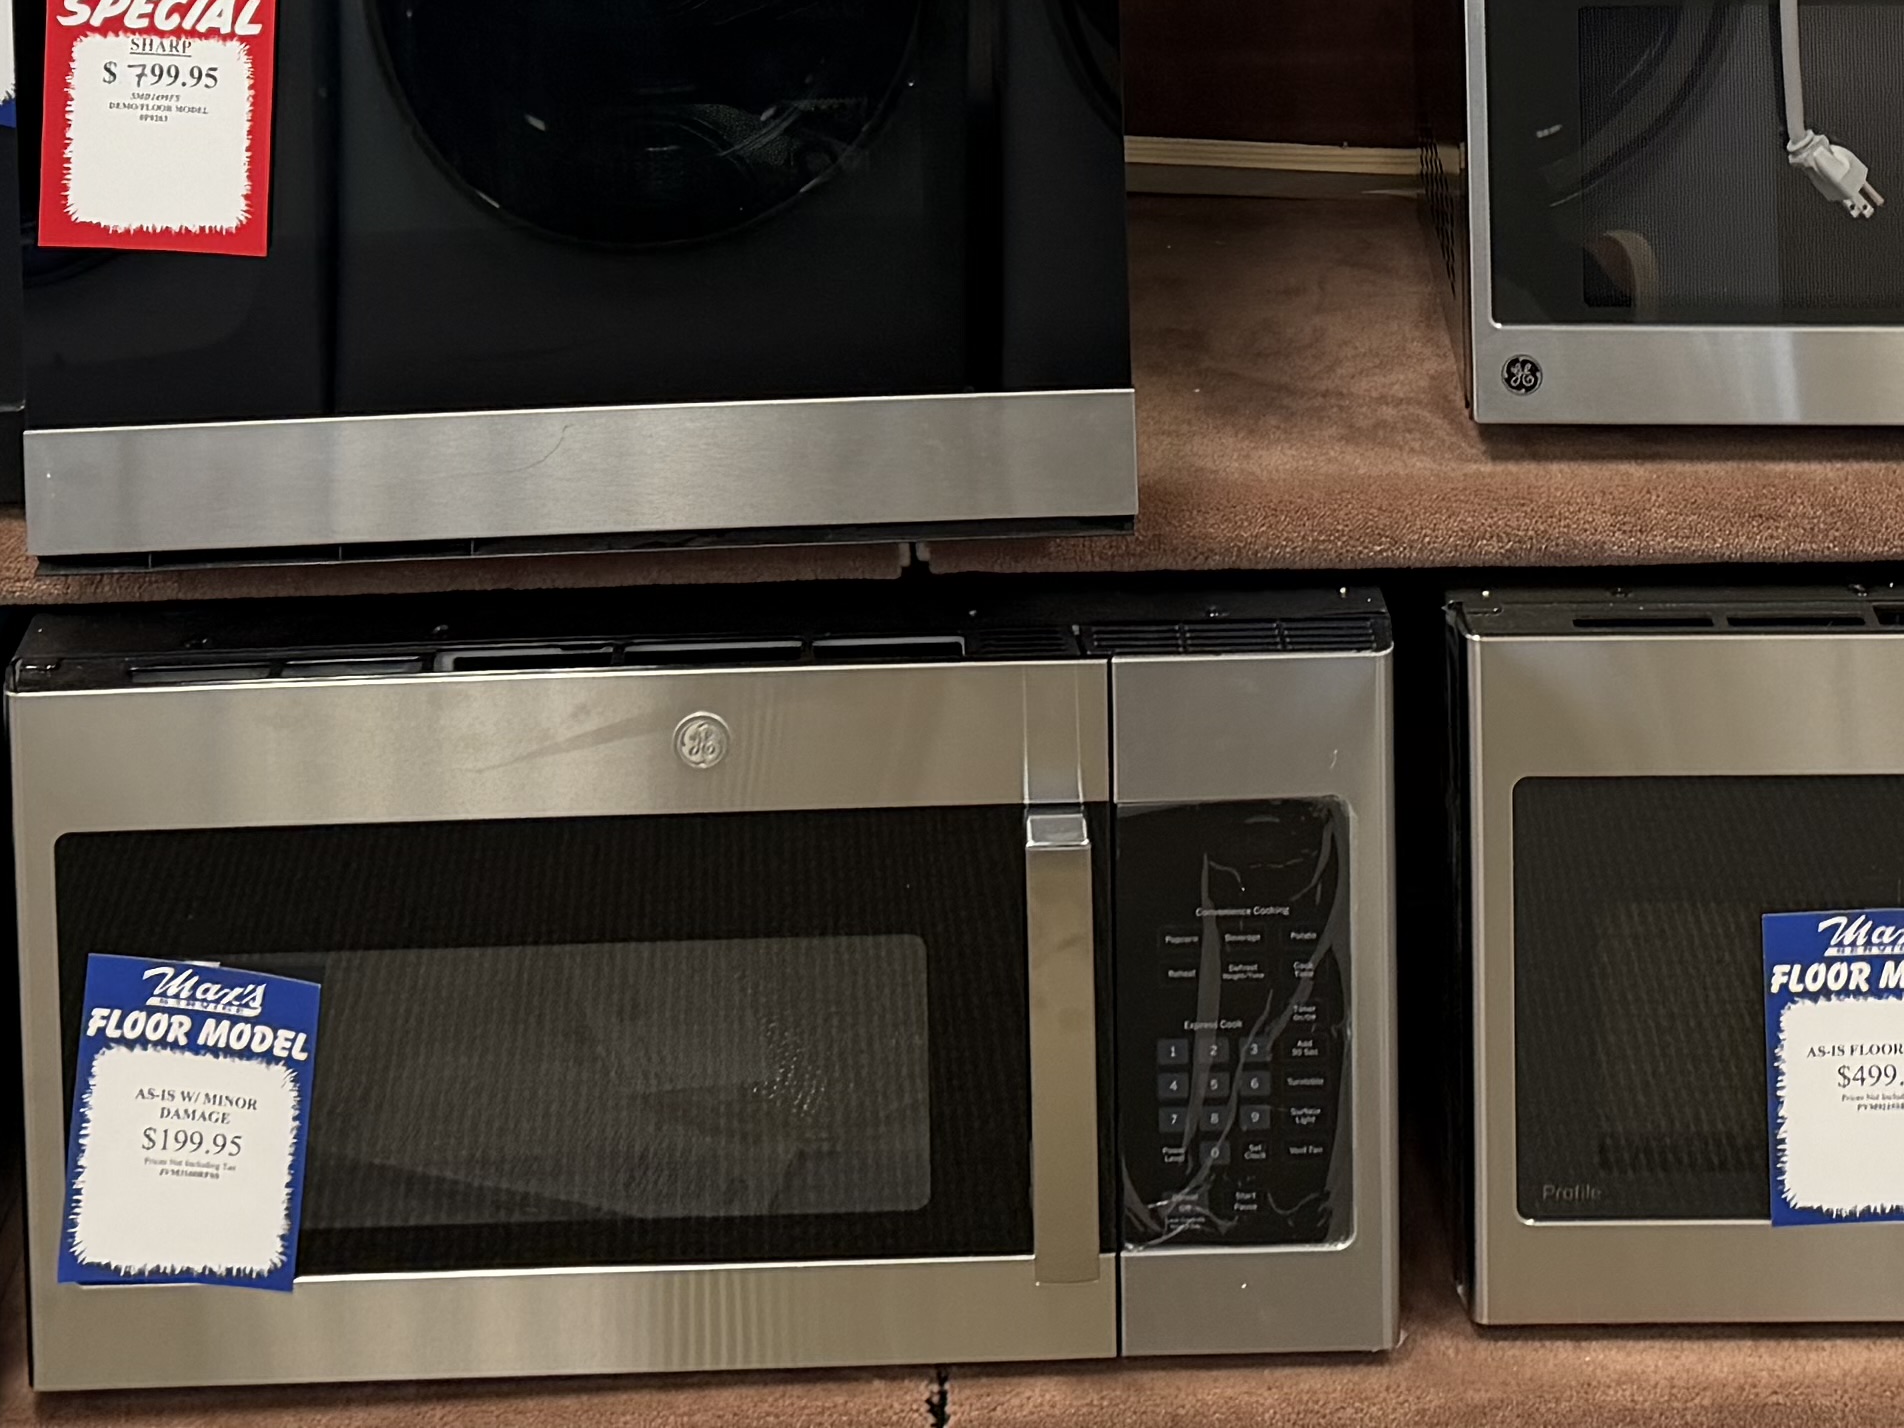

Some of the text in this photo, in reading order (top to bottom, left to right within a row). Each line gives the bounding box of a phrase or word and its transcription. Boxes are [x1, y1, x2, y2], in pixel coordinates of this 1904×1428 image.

[130, 38, 192, 57] SHARP
[127, 63, 219, 89] 799.95
[1770, 961, 1871, 994] FLOOR
[86, 1007, 308, 1061] FLOOR MODEL
[1807, 1045, 1845, 1058] AS-IS
[1850, 1043, 1904, 1056] FLOOR
[135, 1088, 257, 1111] AS-IS W/ MINOR
[160, 1107, 231, 1124] DAMAGE
[142, 1127, 243, 1157] $199.95
